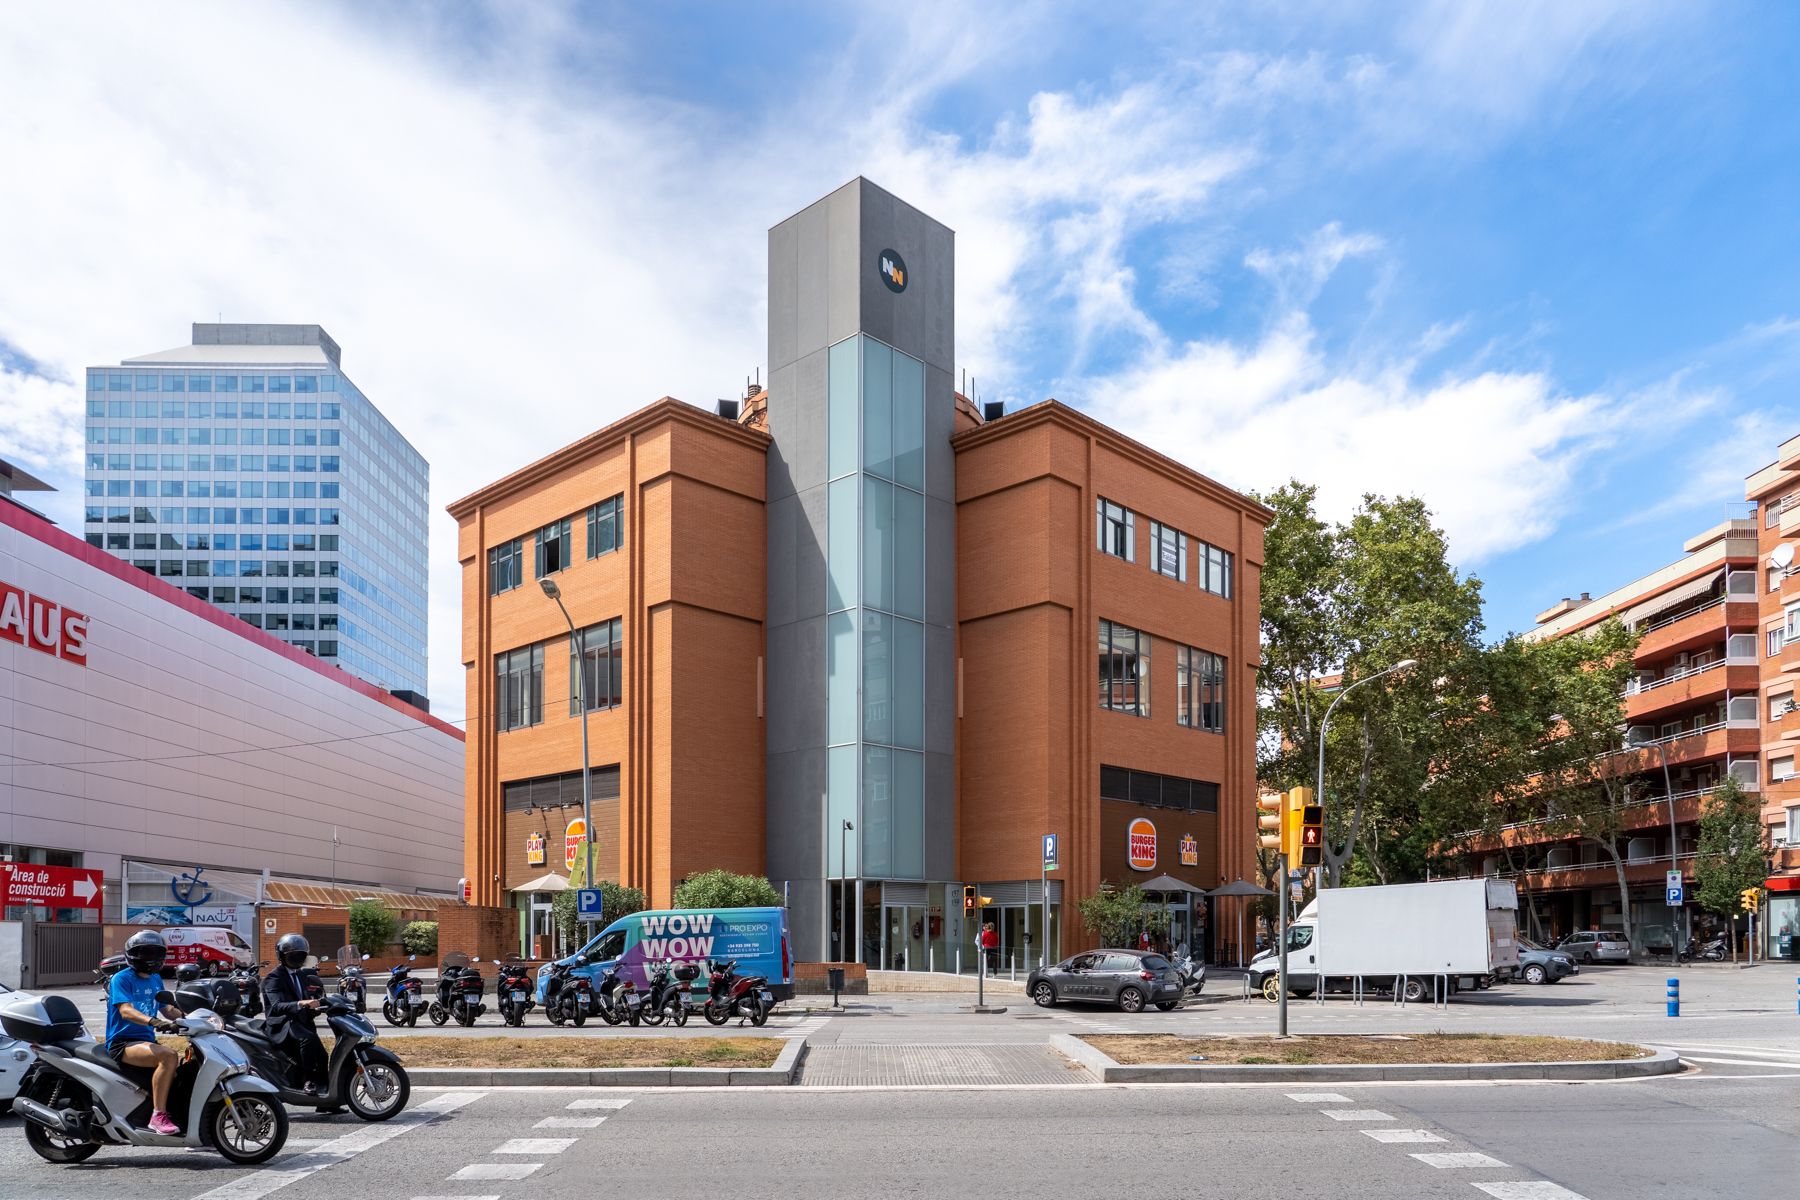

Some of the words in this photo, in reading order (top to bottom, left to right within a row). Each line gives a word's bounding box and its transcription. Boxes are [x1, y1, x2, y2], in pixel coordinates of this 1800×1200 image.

[527, 840, 543, 851] PLAY
[1131, 834, 1156, 846] BURGER
[1131, 845, 1156, 859] KING
[1181, 841, 1196, 853] PLAY
[528, 850, 543, 862] KING
[1182, 851, 1197, 864] KING
[10, 865, 35, 882] Àrea
[37, 870, 49, 883] de
[8, 883, 67, 898] construcció
[1670, 889, 1680, 900] P
[581, 891, 597, 911] P
[641, 914, 714, 936] WOW
[641, 936, 715, 959] WOW
